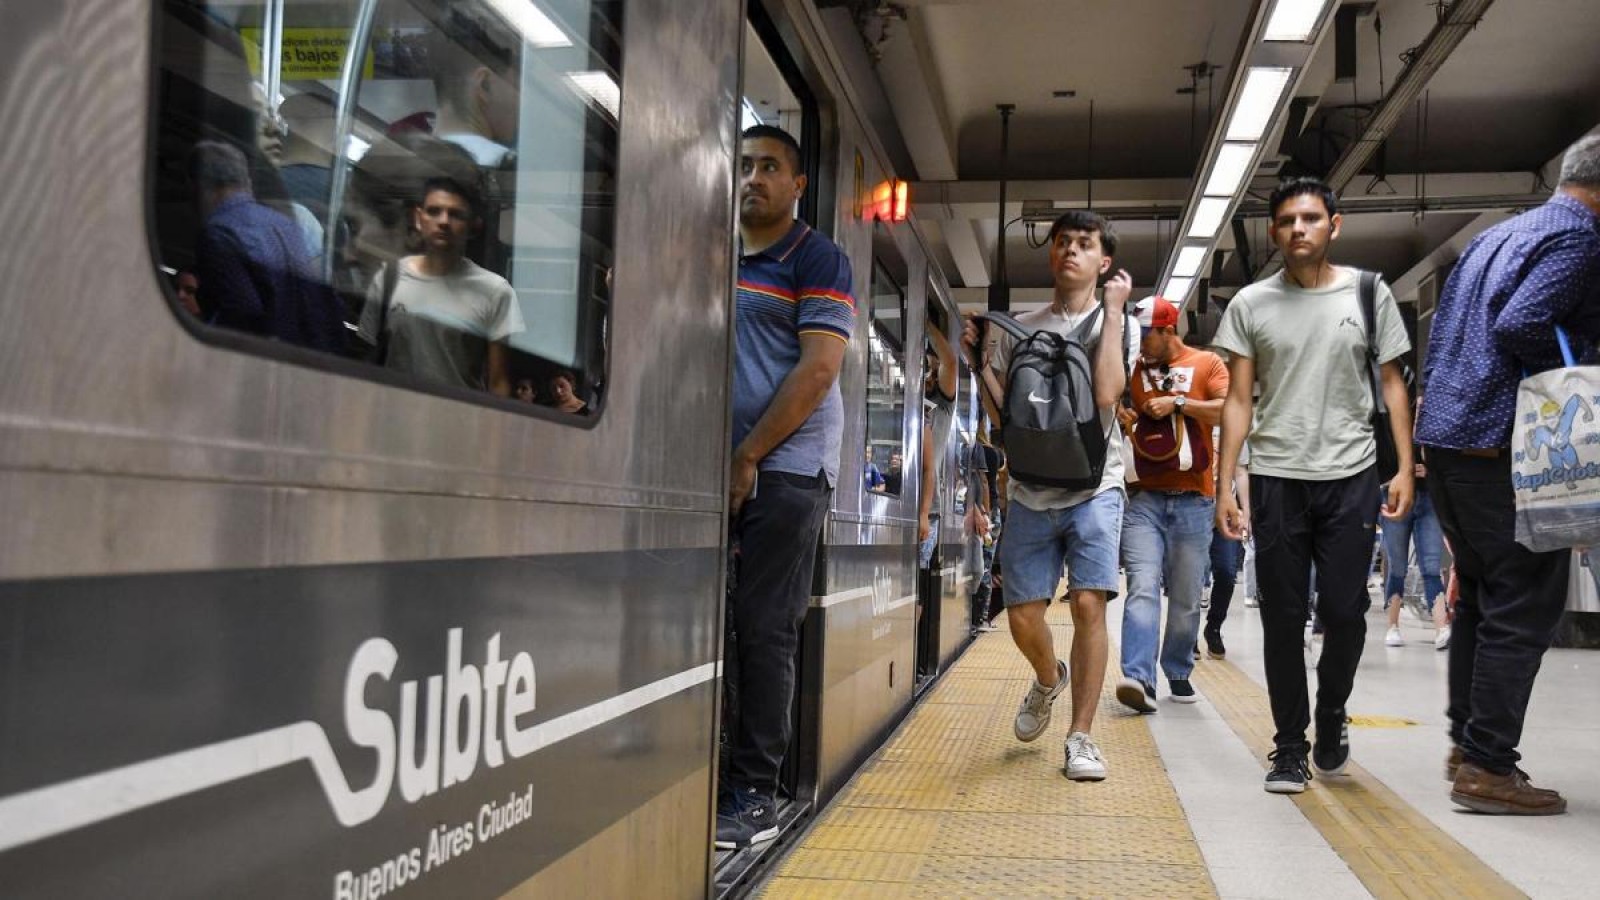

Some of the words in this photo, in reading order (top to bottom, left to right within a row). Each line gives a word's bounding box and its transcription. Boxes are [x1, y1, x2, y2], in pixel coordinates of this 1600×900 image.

[295, 48, 339, 64] bajos
[335, 627, 536, 827] Subte
[334, 848, 421, 900] Buenos
[424, 824, 474, 872] Aires
[477, 784, 533, 843] Ciudad
